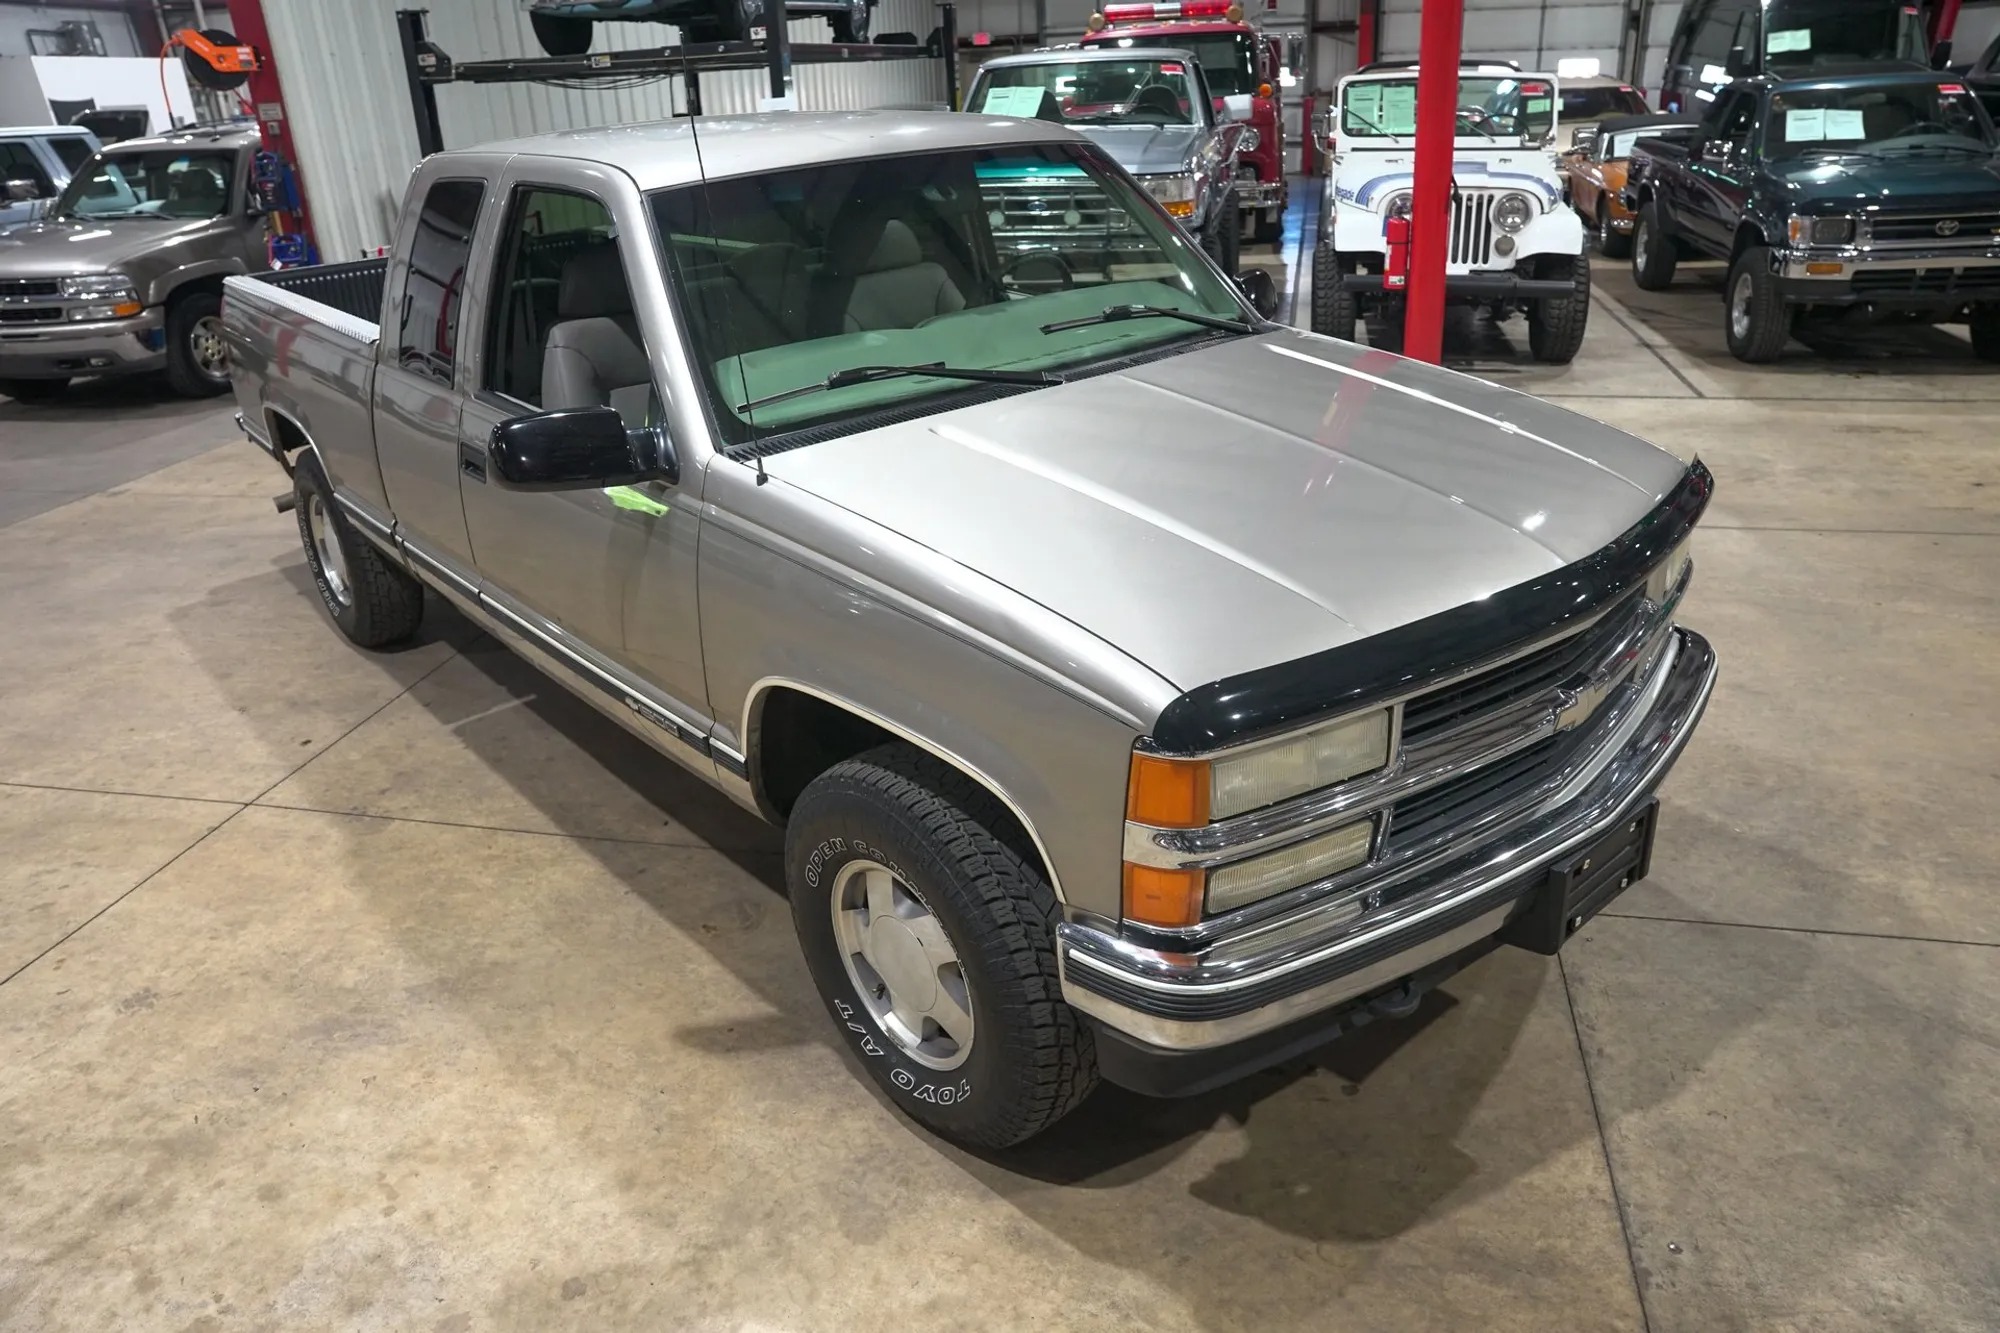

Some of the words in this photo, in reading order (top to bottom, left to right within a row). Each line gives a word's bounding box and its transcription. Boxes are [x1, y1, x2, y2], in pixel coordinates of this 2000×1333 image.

[805, 837, 847, 887] OPEN
[834, 999, 884, 1056] A/T
[891, 1068, 971, 1105] TOYO
